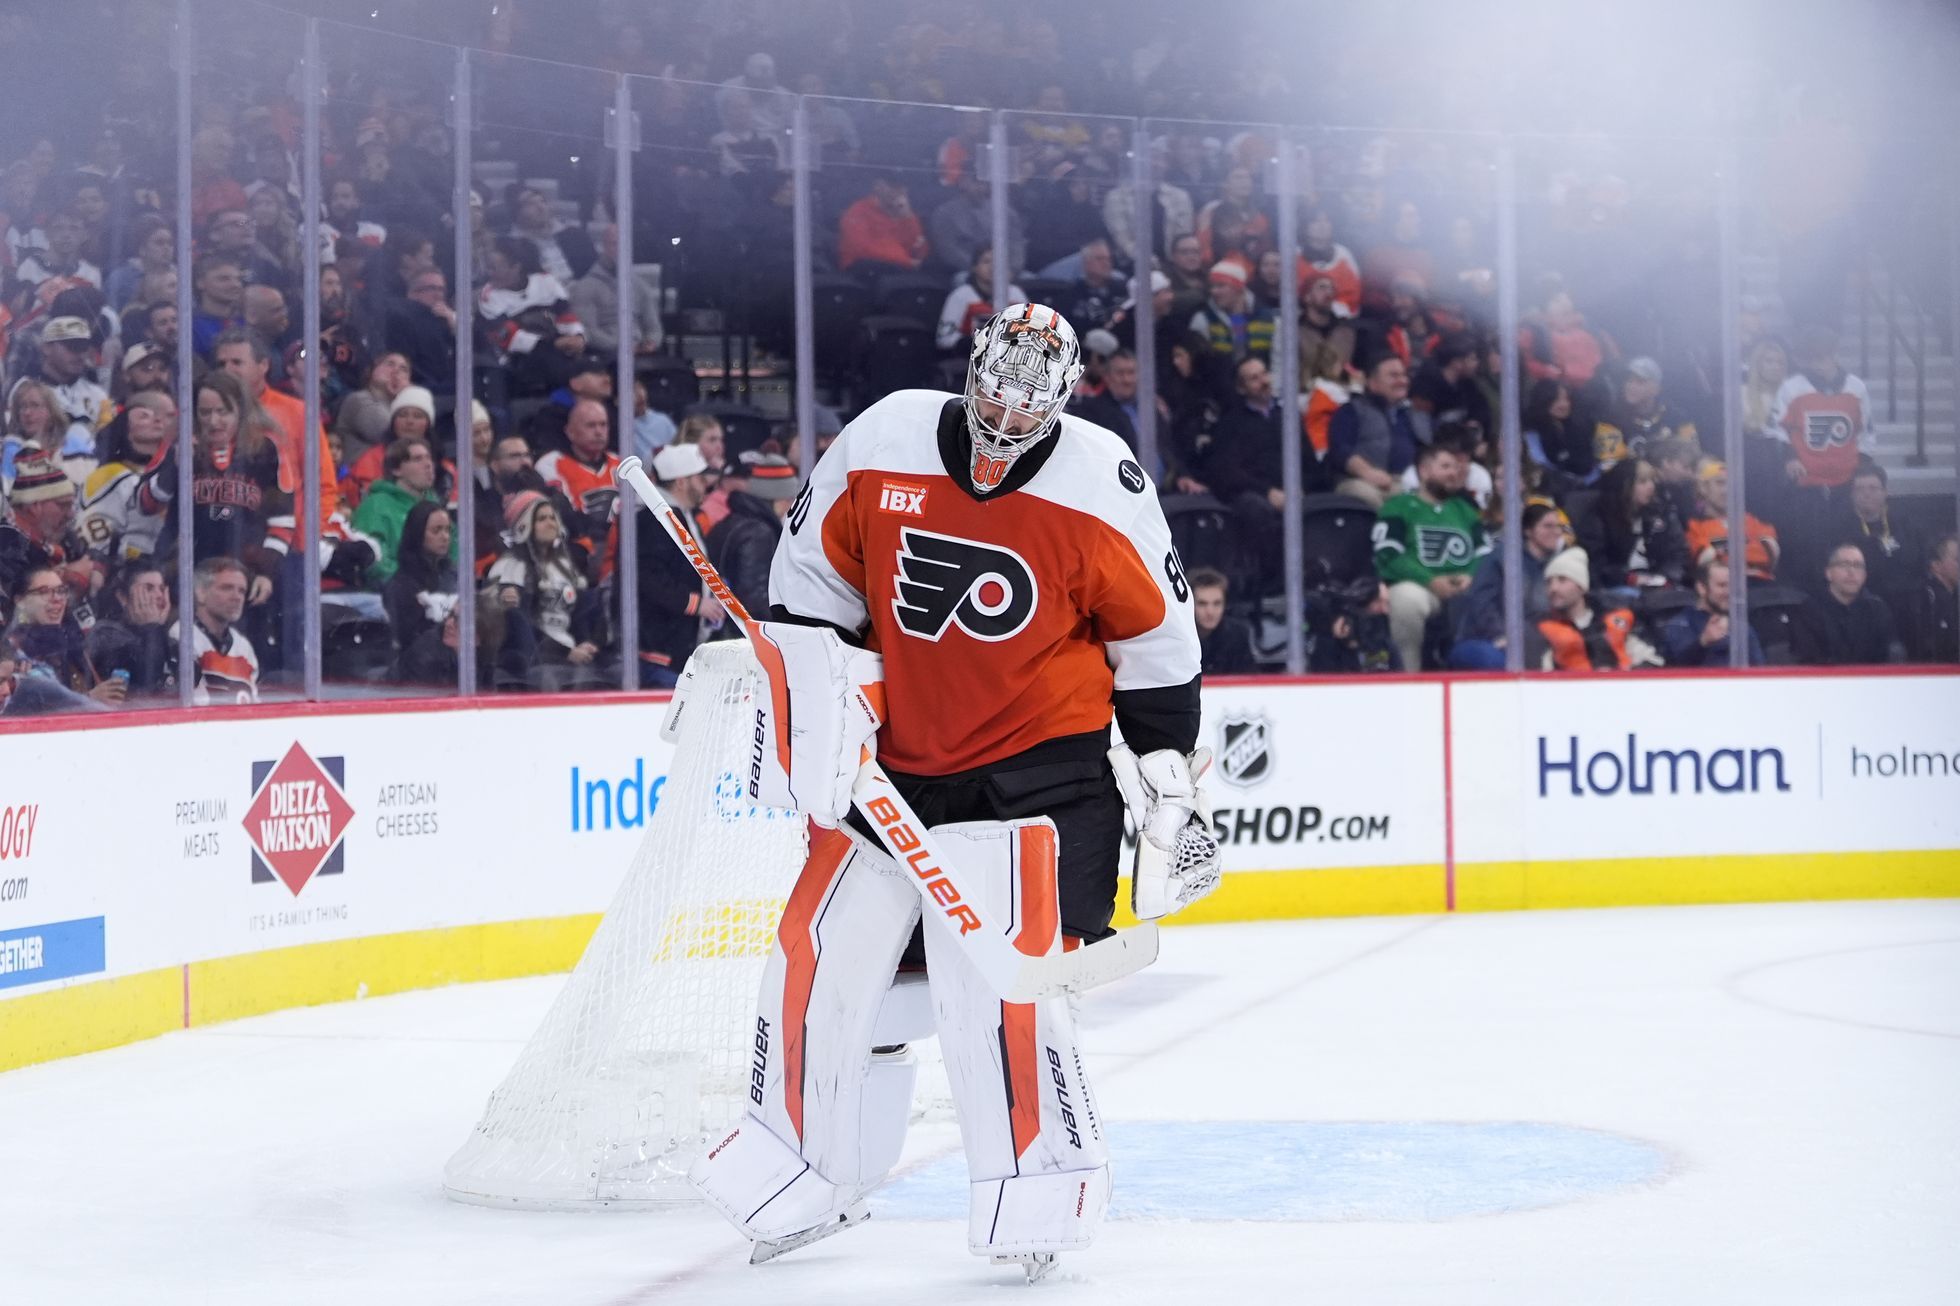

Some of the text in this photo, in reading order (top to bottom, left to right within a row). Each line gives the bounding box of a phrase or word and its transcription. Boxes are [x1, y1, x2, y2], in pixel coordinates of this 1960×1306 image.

[973, 452, 1008, 486] 80
[879, 489, 926, 515] IBX
[1164, 550, 1189, 604] 8
[749, 708, 767, 800] BAUER
[1538, 733, 1791, 797] Holman
[175, 798, 228, 826] PREMIUM
[377, 783, 437, 808] ARTISAN
[260, 813, 331, 854] WATSON
[375, 811, 438, 838] CHEESES
[183, 832, 220, 859] MEATS
[865, 796, 982, 937] BAUER
[278, 907, 312, 928] FAMILY
[315, 904, 348, 923] THING
[750, 1016, 770, 1107] BAUER
[1045, 1045, 1082, 1150] BAUER
[708, 1128, 740, 1161] SHADOW
[1076, 1181, 1086, 1218] SHADOW
